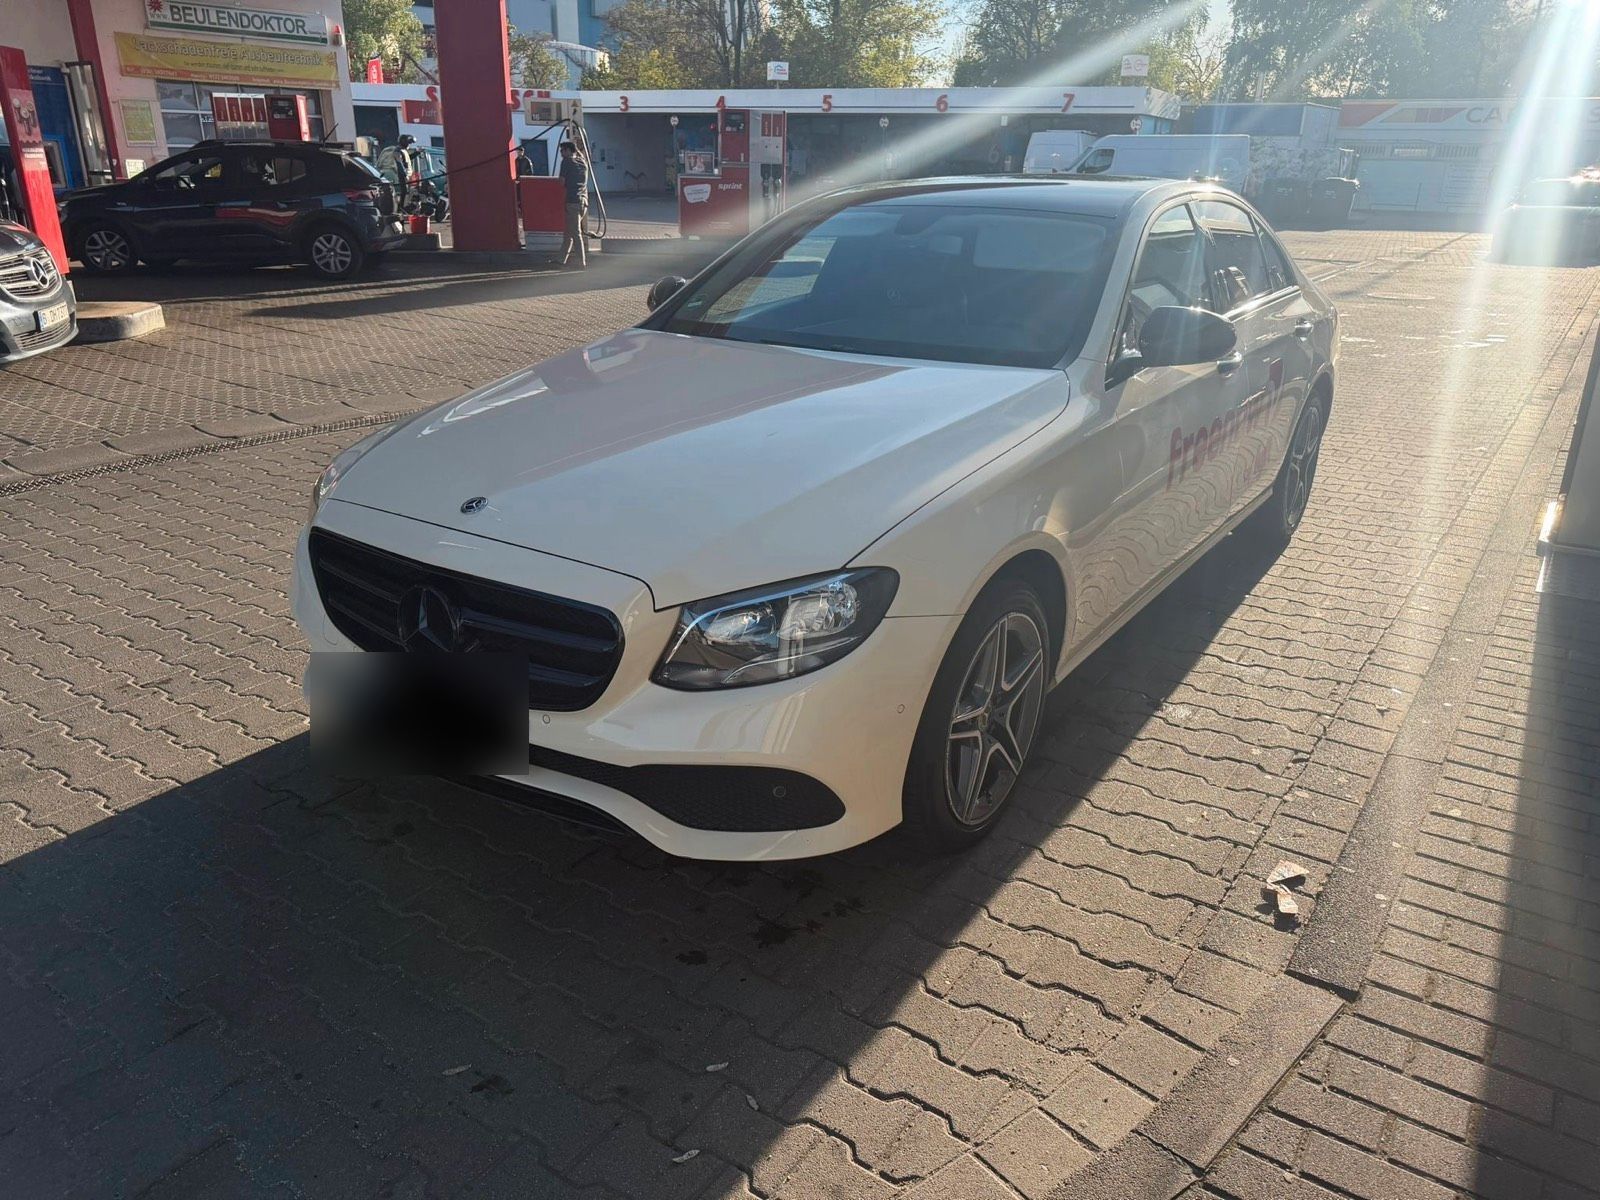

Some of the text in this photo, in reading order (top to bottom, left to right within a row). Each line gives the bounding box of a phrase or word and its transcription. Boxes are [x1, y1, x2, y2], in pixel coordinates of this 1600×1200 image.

[169, 4, 308, 35] BEULENDOKTOR
[241, 47, 321, 66] Ausbeultechnik
[619, 95, 629, 112] 3
[715, 95, 726, 110] 4
[822, 94, 833, 112] 5
[935, 94, 949, 113] 6
[1061, 93, 1076, 113] 7
[718, 182, 743, 191] sprint
